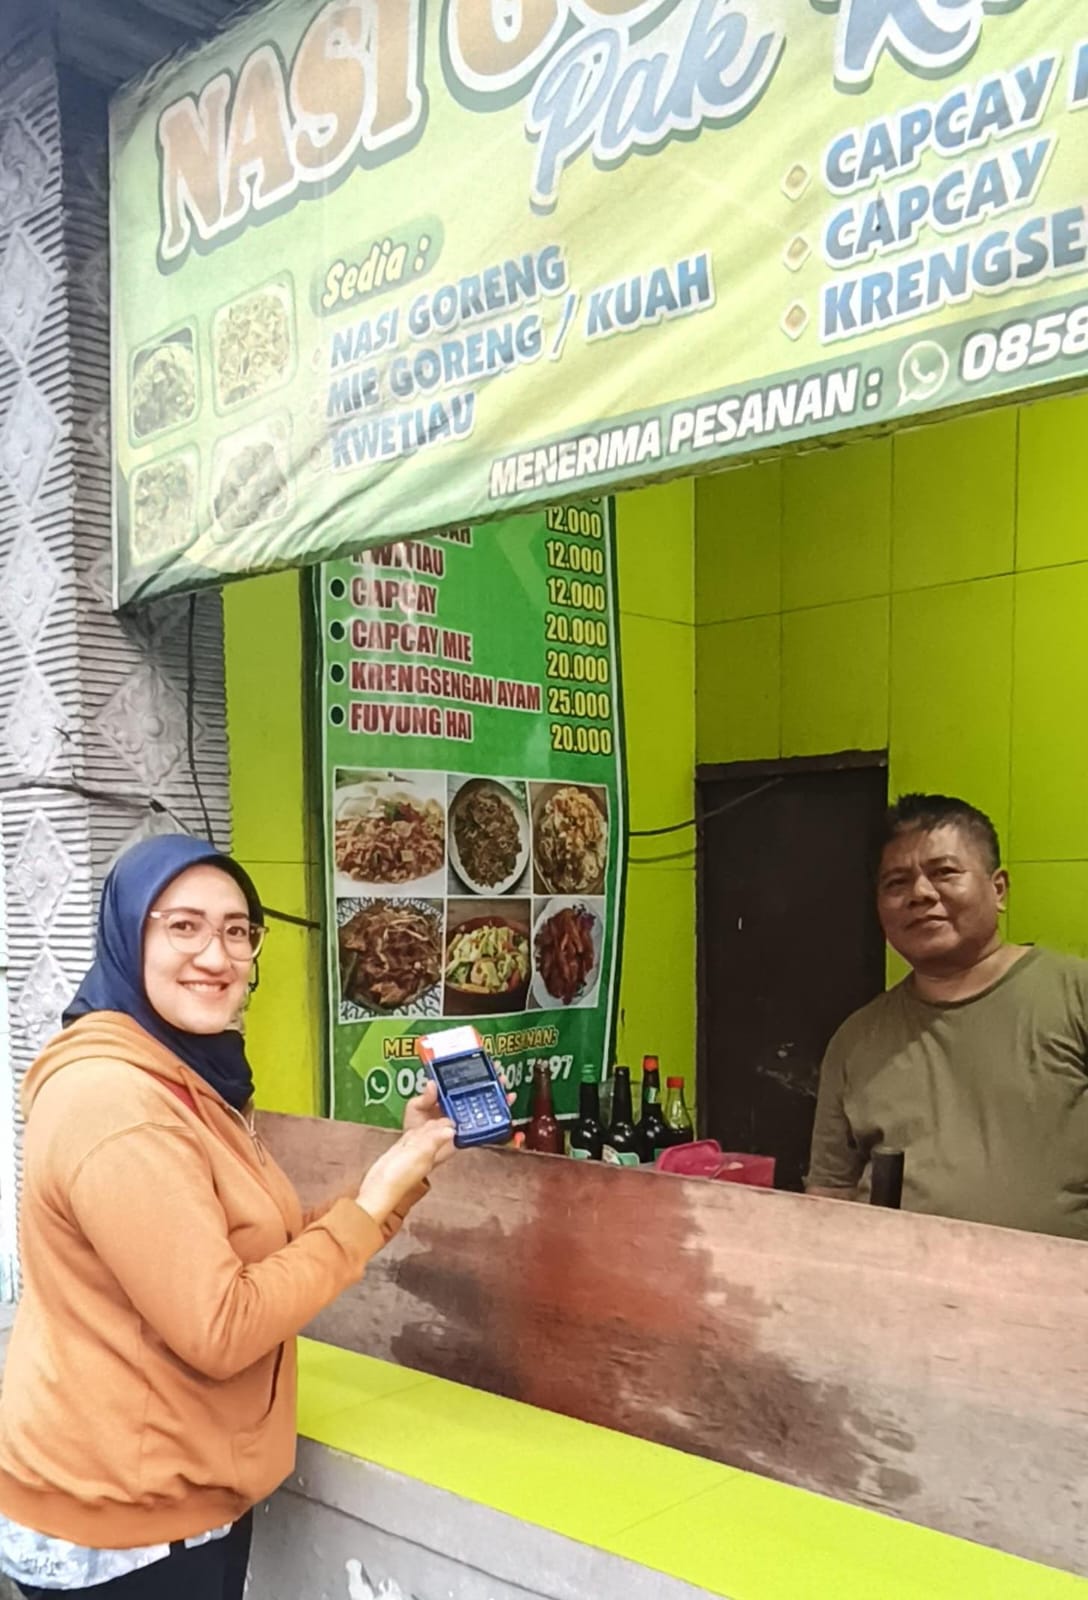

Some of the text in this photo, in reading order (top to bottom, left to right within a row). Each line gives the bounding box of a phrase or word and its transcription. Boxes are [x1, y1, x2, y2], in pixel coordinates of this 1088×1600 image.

[528, 0, 778, 200] Pak
[824, 56, 1056, 189] CAPCAY
[824, 138, 1051, 262] CAPCAY
[321, 239, 406, 308] Sedia
[823, 205, 1087, 339] KRENGSE
[330, 245, 566, 369] NASI GORENG
[326, 366, 377, 418] MIE
[389, 315, 543, 397] GORENG
[586, 253, 711, 337] KUAH
[489, 420, 662, 499] MENERIMA
[961, 305, 1088, 382] 0858
[330, 392, 475, 468] KWETIAU
[547, 505, 602, 538] 12.000
[546, 540, 604, 575] 12.000
[351, 577, 438, 615] CAPCAY
[547, 577, 606, 611] 12.000
[351, 618, 472, 662] CAPCAY MIE
[545, 613, 608, 647] 20.000
[351, 661, 542, 711] KRENGSENGAN AYAM
[546, 650, 609, 684] 20.000
[350, 702, 473, 740] FUYUNG HAI
[547, 687, 610, 719] 25.000
[550, 724, 612, 755] 20.000
